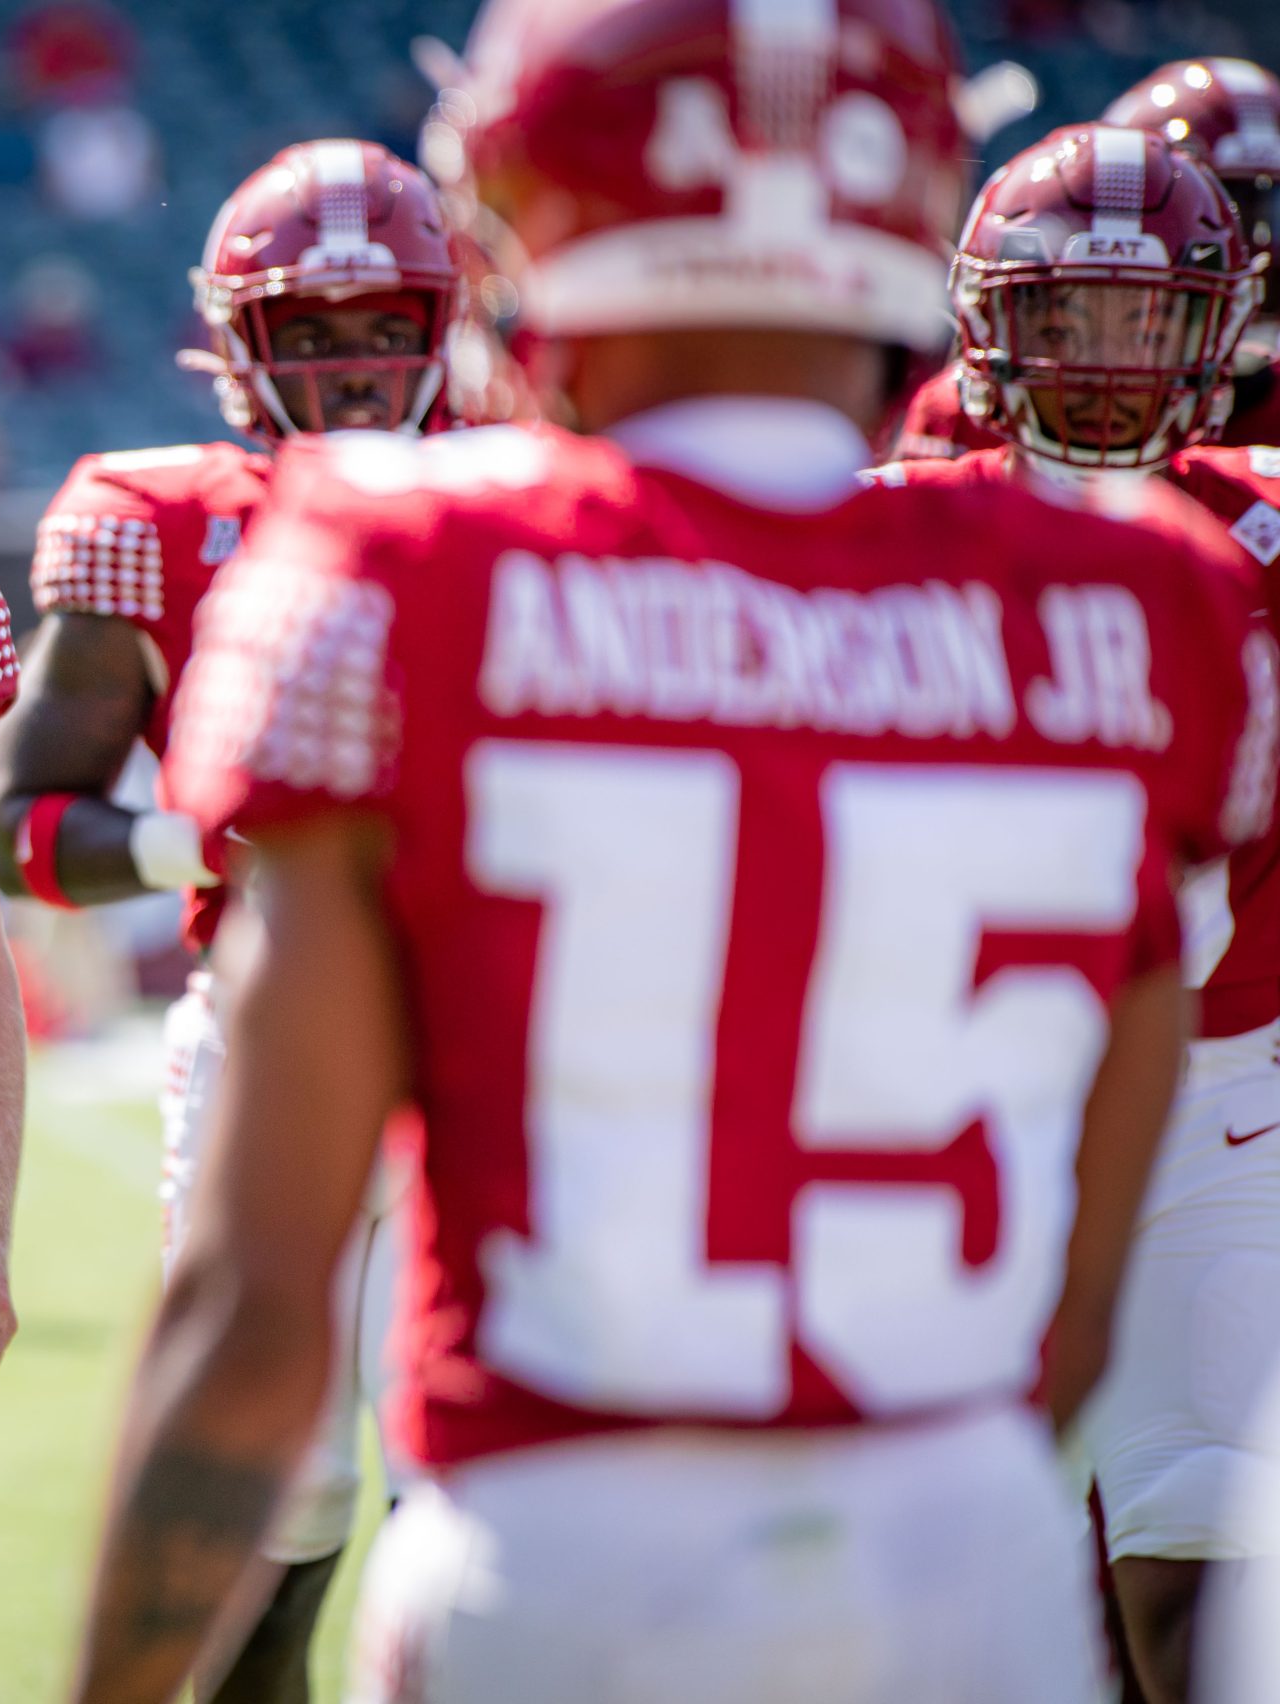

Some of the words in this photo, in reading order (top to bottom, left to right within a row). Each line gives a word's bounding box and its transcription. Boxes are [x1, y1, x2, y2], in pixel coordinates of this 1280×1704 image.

[1088, 238, 1146, 258] EAT
[478, 548, 1017, 740] ANDERSON
[464, 735, 1150, 1420] 15
